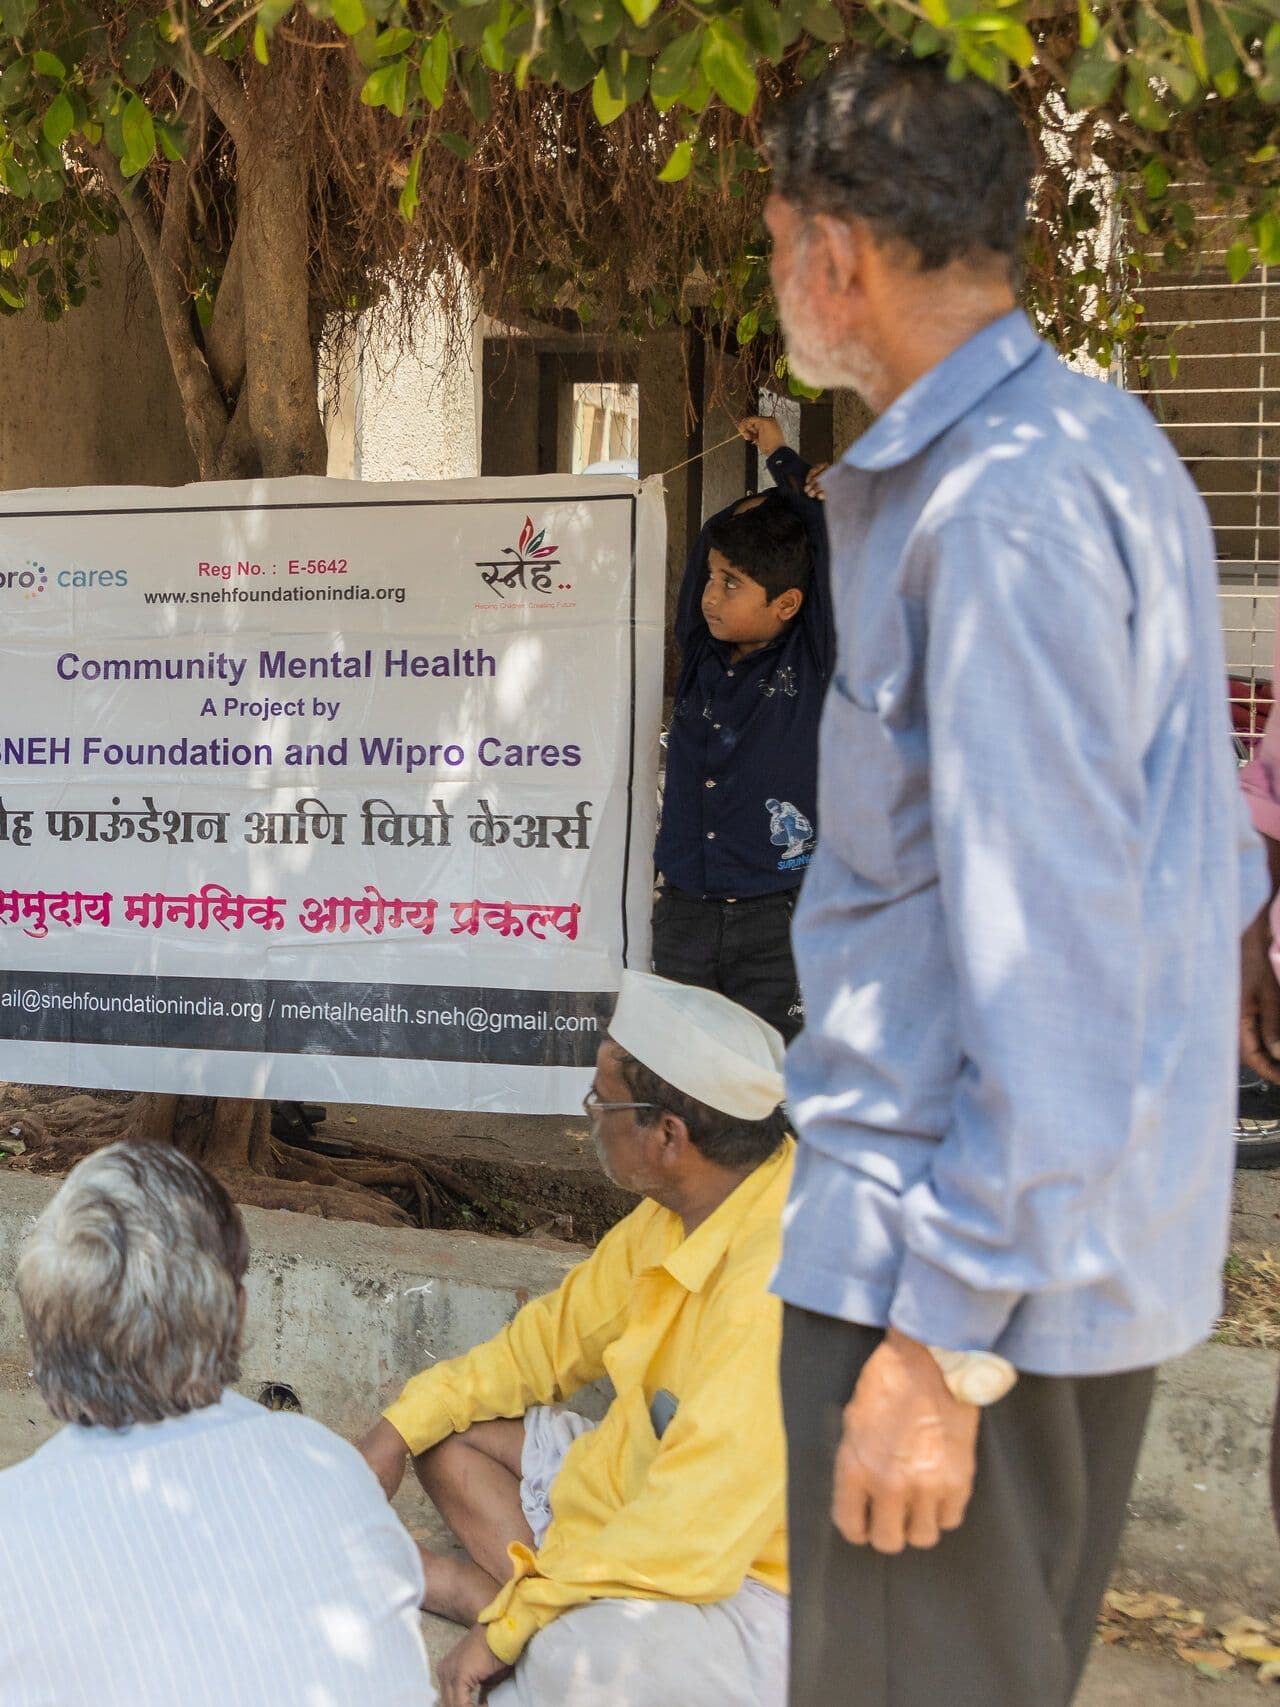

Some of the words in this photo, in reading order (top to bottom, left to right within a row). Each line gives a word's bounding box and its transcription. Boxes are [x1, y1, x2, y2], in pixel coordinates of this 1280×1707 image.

[57, 567, 129, 588] cares
[198, 562, 232, 579] Reg
[237, 561, 266, 577] No.
[288, 558, 348, 576] E-5642
[144, 585, 407, 605] www.snehfoundationindia.org
[56, 652, 248, 687] Community
[259, 650, 373, 681] Mental
[384, 649, 498, 679] Health
[200, 698, 217, 717] A
[224, 697, 305, 721] Project
[312, 697, 340, 721] by
[83, 737, 273, 768] Foundation
[284, 738, 350, 767] and
[359, 737, 465, 774] Wipro
[477, 736, 583, 768] Cares
[46, 796, 228, 846] फाऊंडेशन
[244, 798, 348, 847] आणि
[360, 799, 453, 849] विप्रो
[467, 799, 594, 851] केअर्स
[123, 883, 287, 933] मानसिक
[297, 885, 437, 937] आरोग्य
[450, 900, 583, 942] प्रकल्प
[281, 1001, 597, 1033] mentalhealth.sneh@gmail.com
